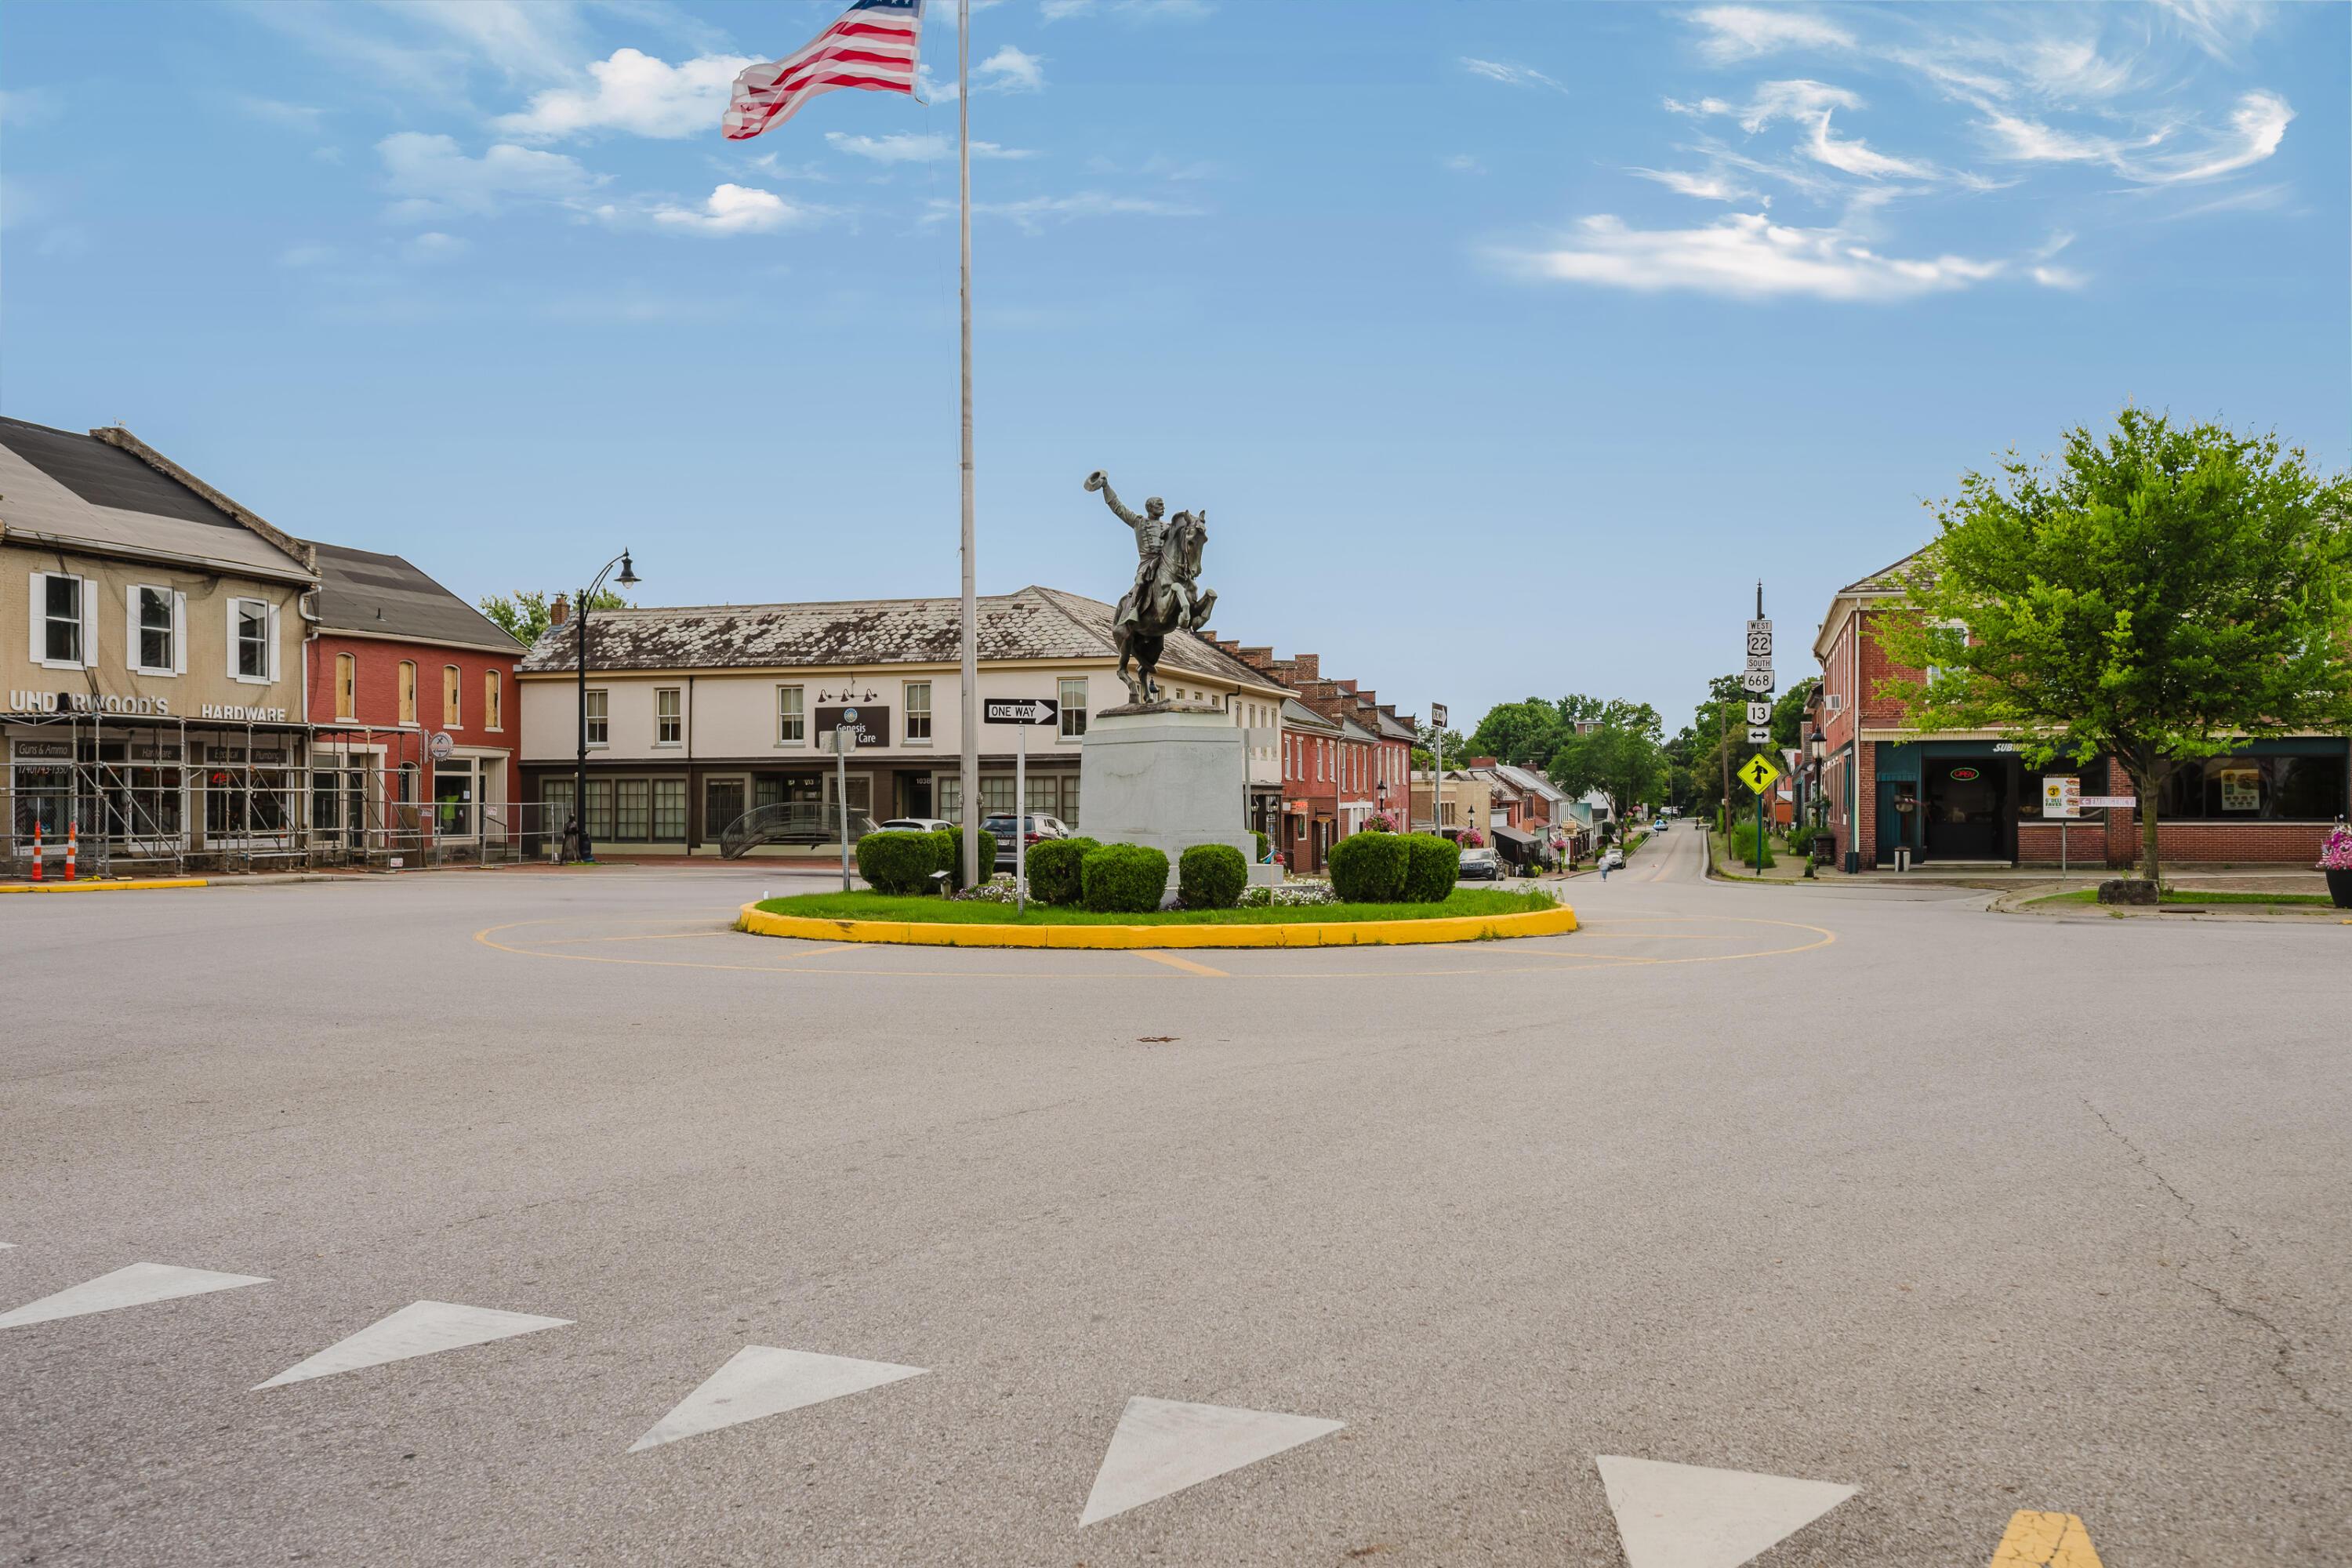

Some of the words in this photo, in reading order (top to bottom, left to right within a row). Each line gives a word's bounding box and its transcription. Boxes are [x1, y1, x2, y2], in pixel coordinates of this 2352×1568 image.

[1751, 637, 1768, 651] 22
[1748, 659, 1770, 667] SOUTH
[1748, 675, 1769, 686] 668
[9, 690, 169, 715] UNDRWOOD'S
[201, 704, 286, 721] HARDWARE
[992, 706, 1011, 717] ONE
[1015, 706, 1035, 717] WAY
[1751, 707, 1766, 720] 13
[837, 723, 866, 733] Genesis
[858, 733, 877, 743] Care
[19, 744, 38, 755] Guns
[38, 745, 44, 755] &
[45, 744, 68, 755] Ammo
[214, 749, 239, 759] Eectcal
